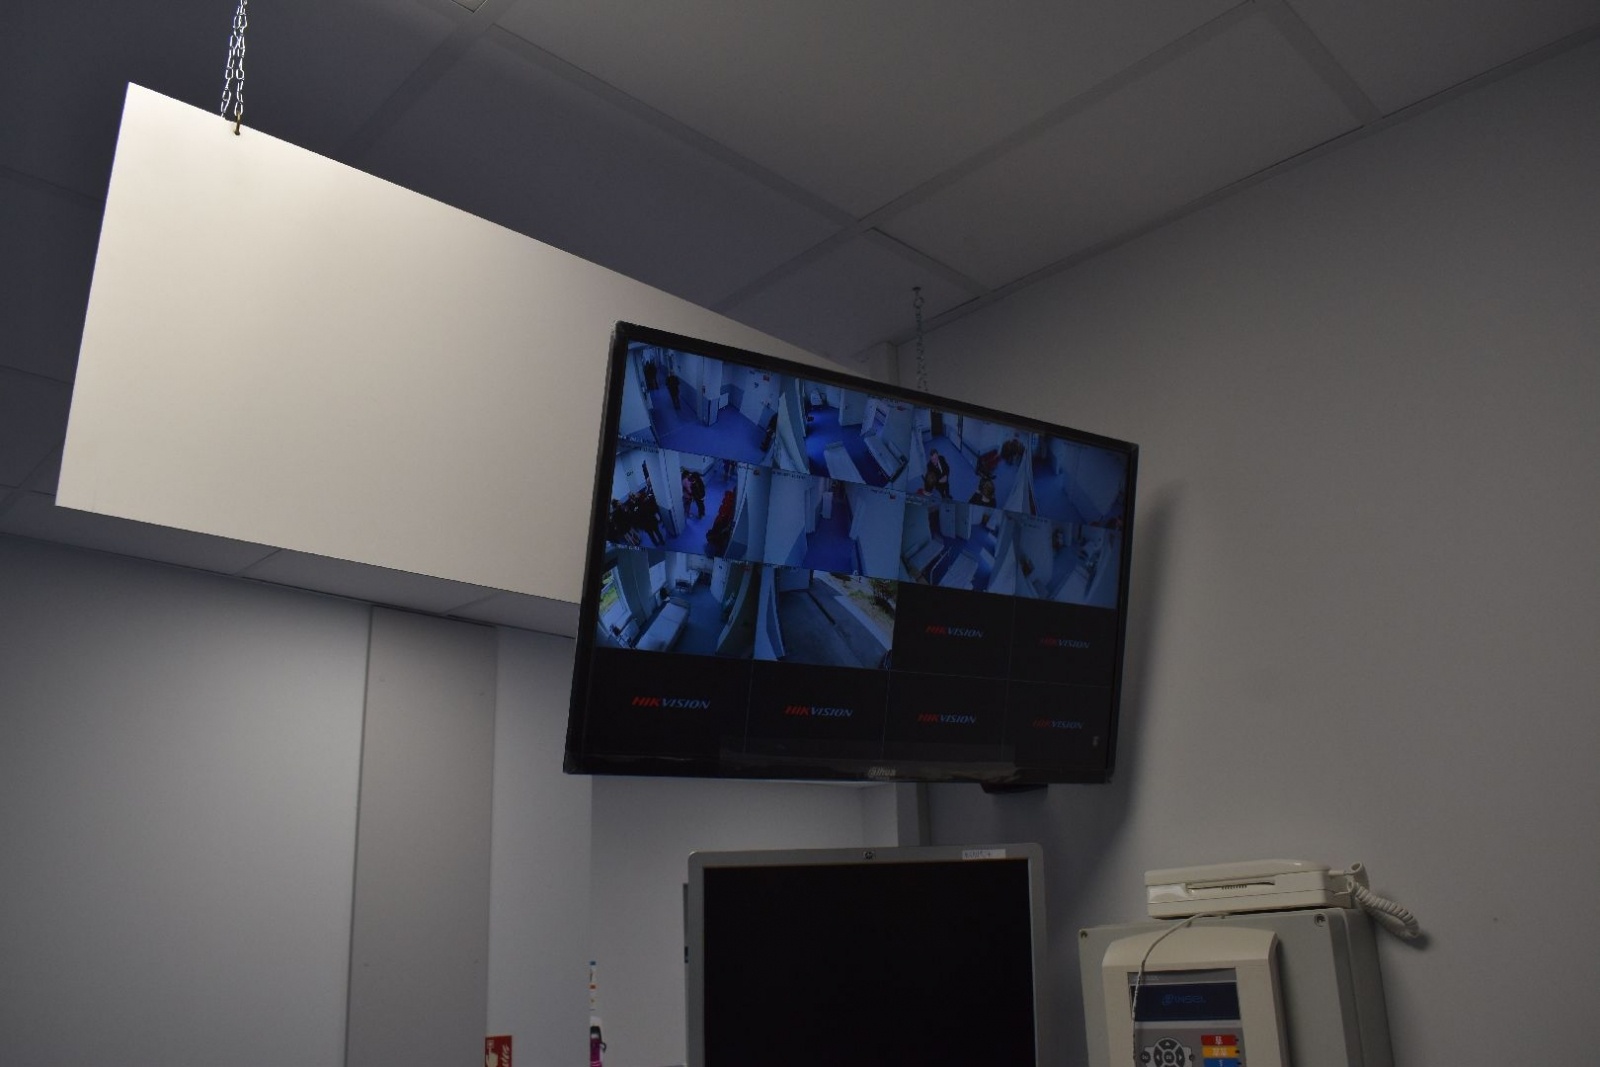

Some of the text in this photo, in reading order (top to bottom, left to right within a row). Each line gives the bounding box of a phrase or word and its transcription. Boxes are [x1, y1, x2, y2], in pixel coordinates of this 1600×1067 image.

[926, 625, 983, 640] HIKVISION
[1040, 637, 1091, 649] HIKVISION
[632, 696, 710, 710] HIKVISION
[785, 704, 854, 717] HIKVISION
[917, 713, 977, 725] HIKVISION
[1033, 719, 1083, 730] HIKVISION
